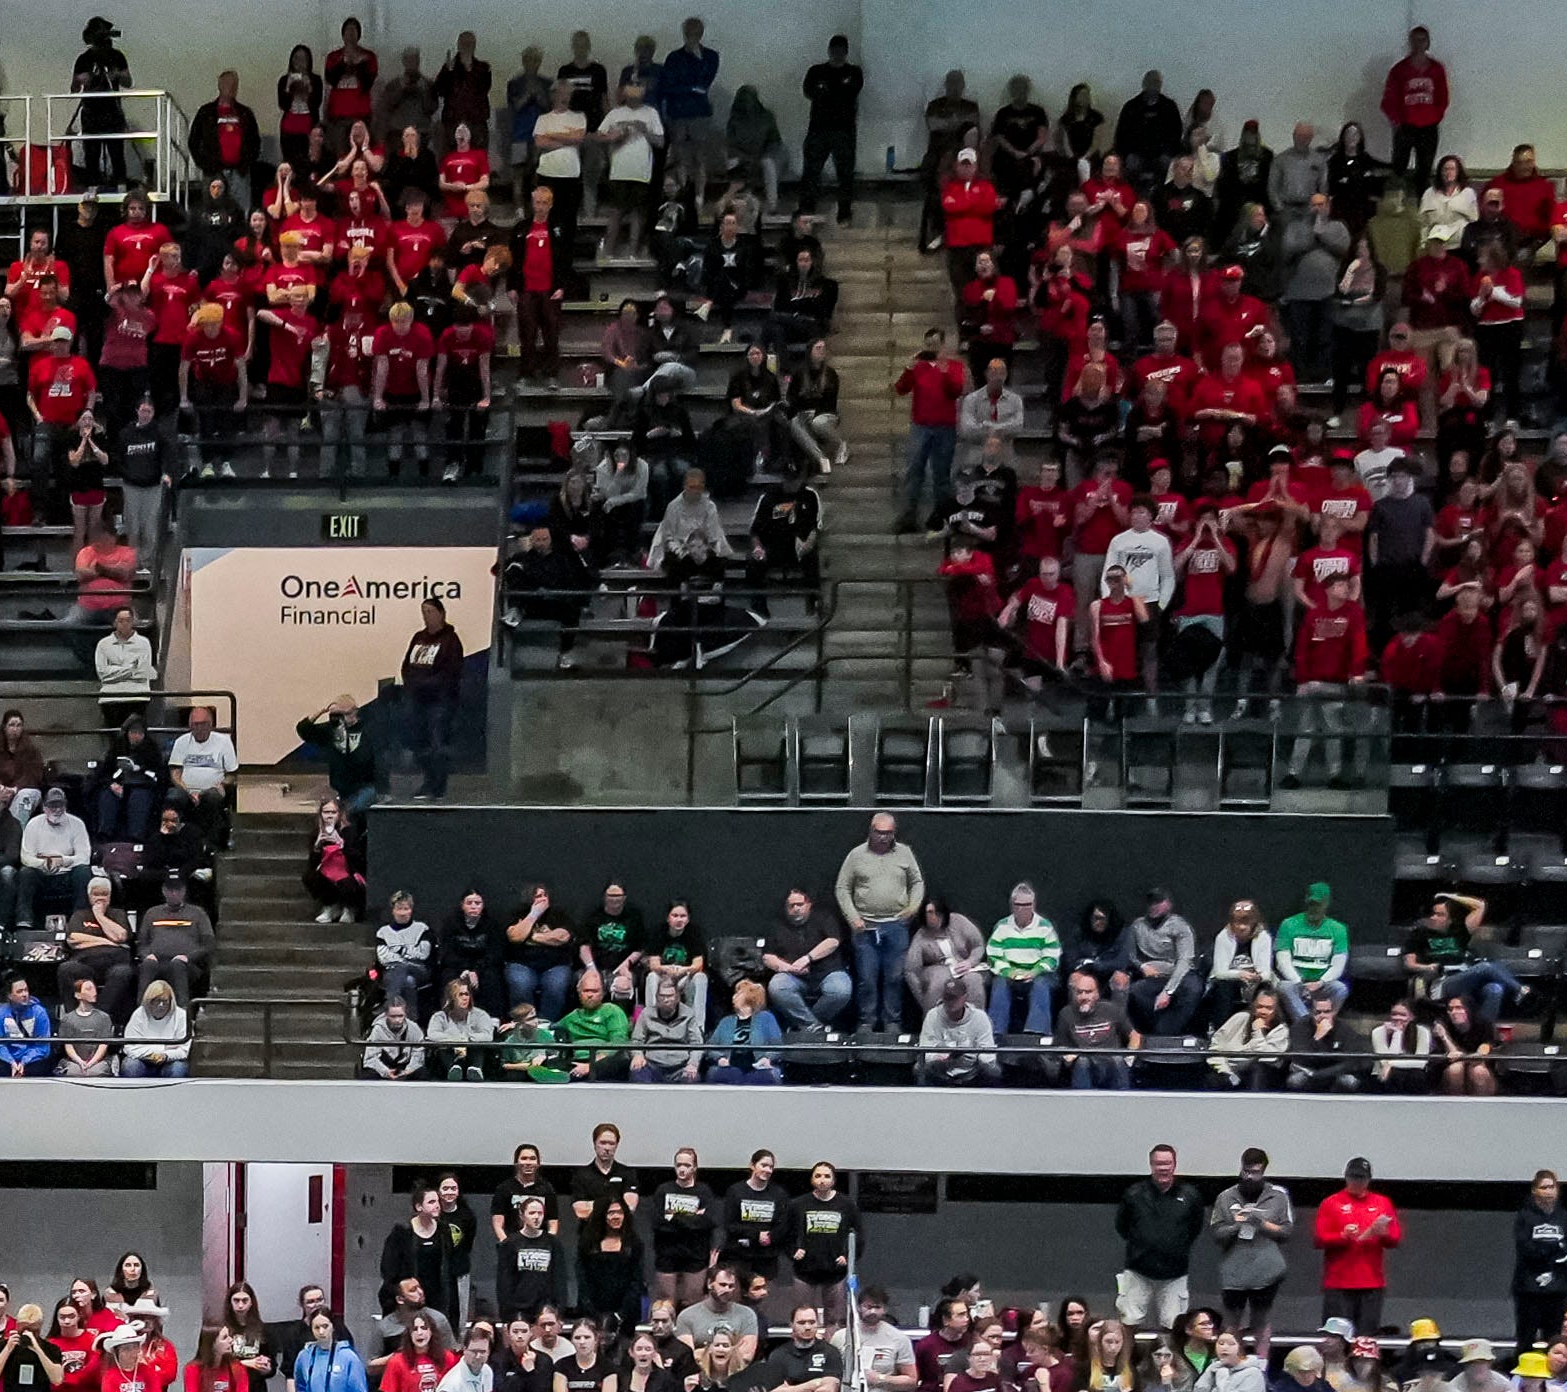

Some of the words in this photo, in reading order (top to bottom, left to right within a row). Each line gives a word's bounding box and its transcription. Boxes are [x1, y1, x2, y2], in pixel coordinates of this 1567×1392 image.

[330, 516, 359, 537] EXIT
[281, 575, 461, 599] OneAmerica
[280, 606, 375, 625] Financial
